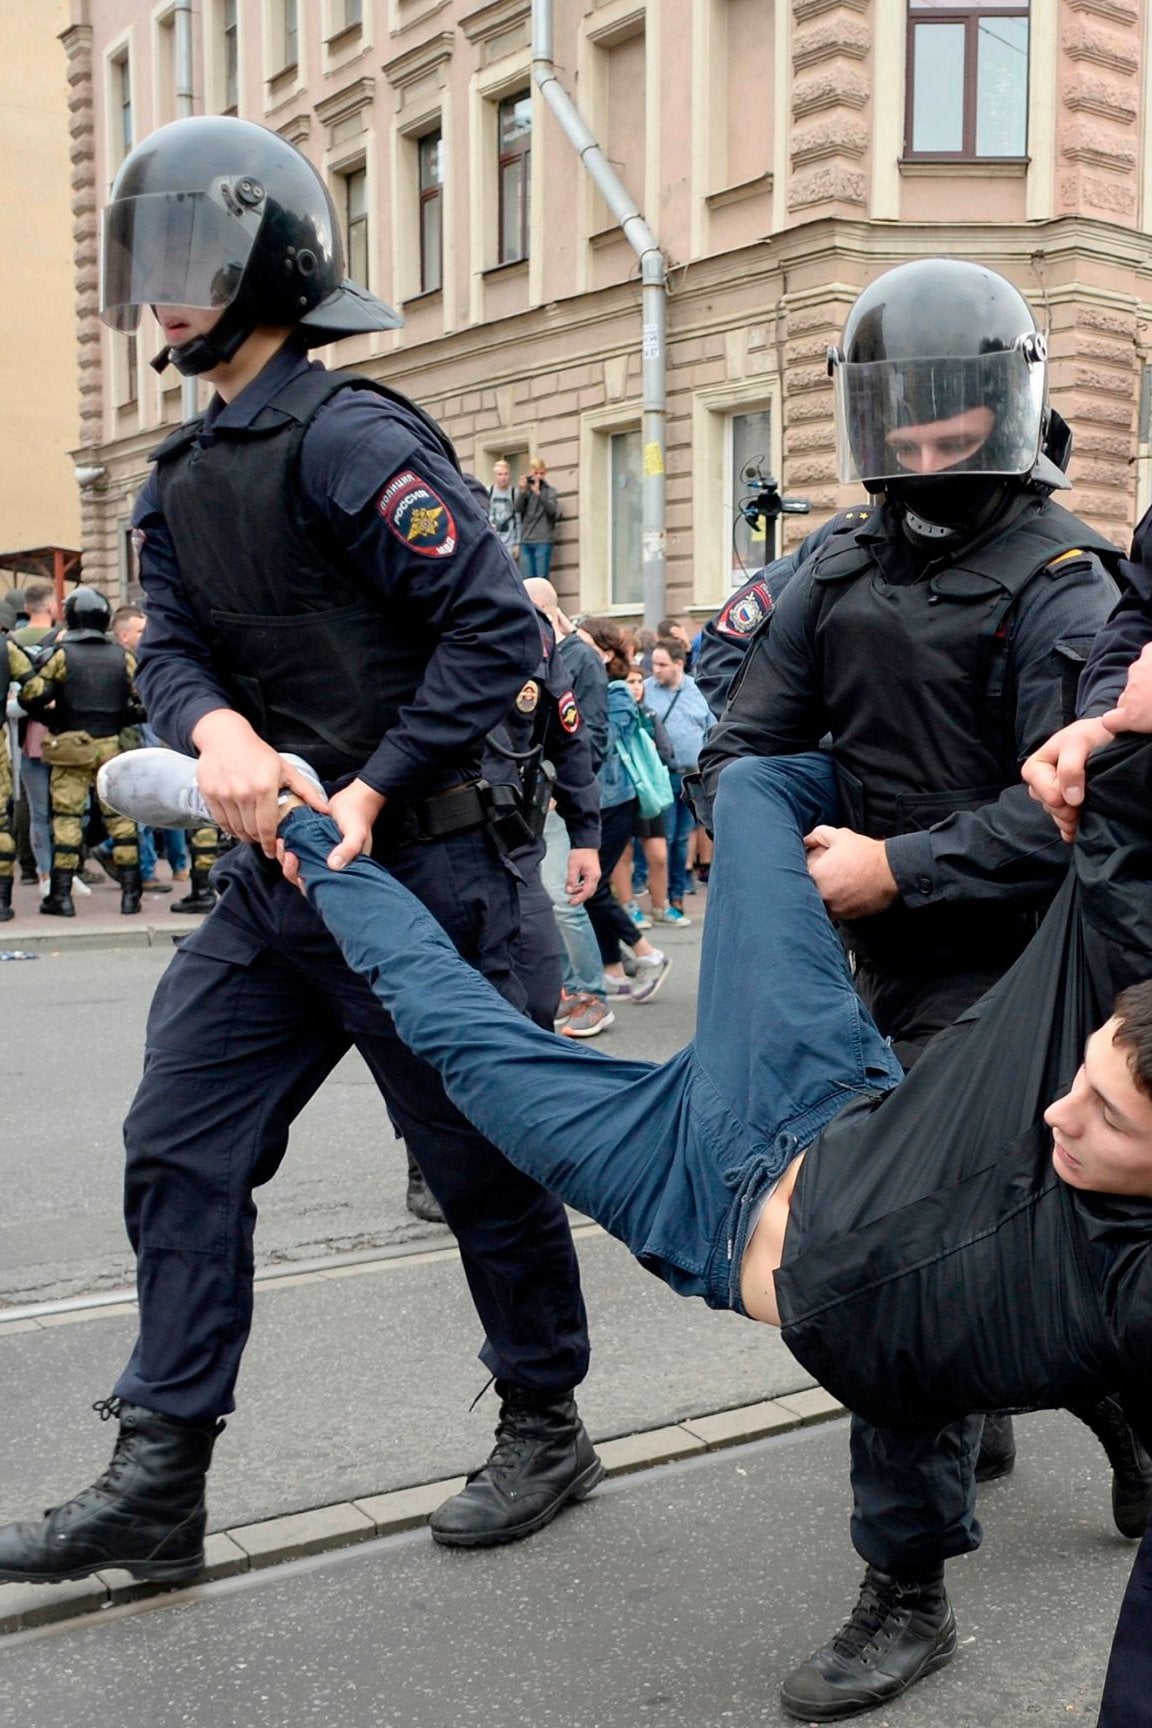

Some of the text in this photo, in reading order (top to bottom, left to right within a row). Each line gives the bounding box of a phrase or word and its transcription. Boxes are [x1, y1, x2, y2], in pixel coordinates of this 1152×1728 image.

[380, 474, 415, 511] ПОЛИЦИЯ
[393, 489, 430, 526] РОССИЯ
[435, 536, 456, 555] МВД
